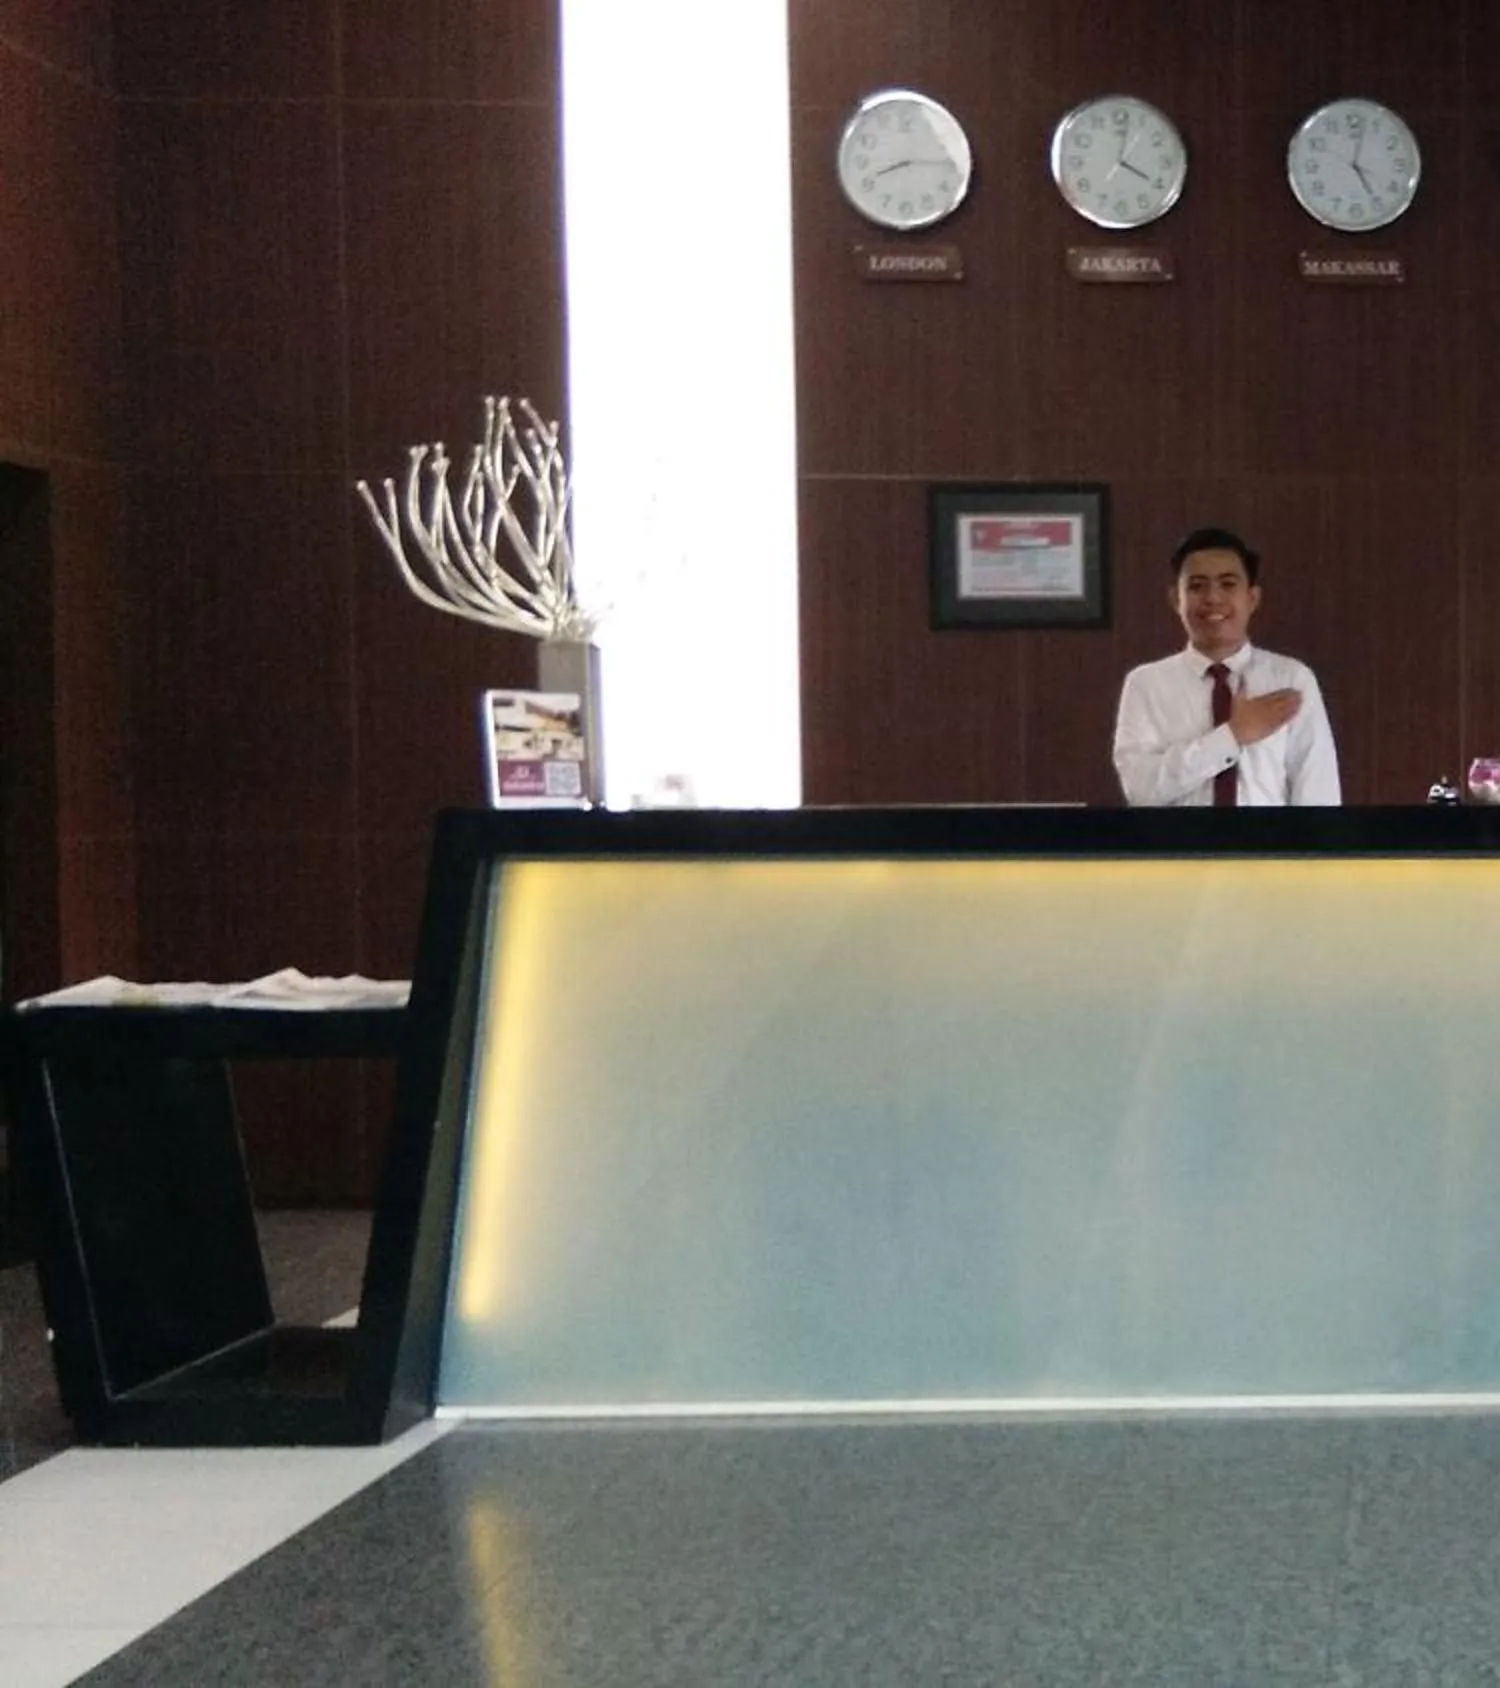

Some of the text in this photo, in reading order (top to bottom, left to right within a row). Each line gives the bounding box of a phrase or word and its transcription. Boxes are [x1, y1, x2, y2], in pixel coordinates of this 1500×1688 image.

[869, 255, 947, 271] LONDON
[1079, 257, 1162, 273] JAKARTA
[1303, 260, 1401, 276] MAKASSAR
